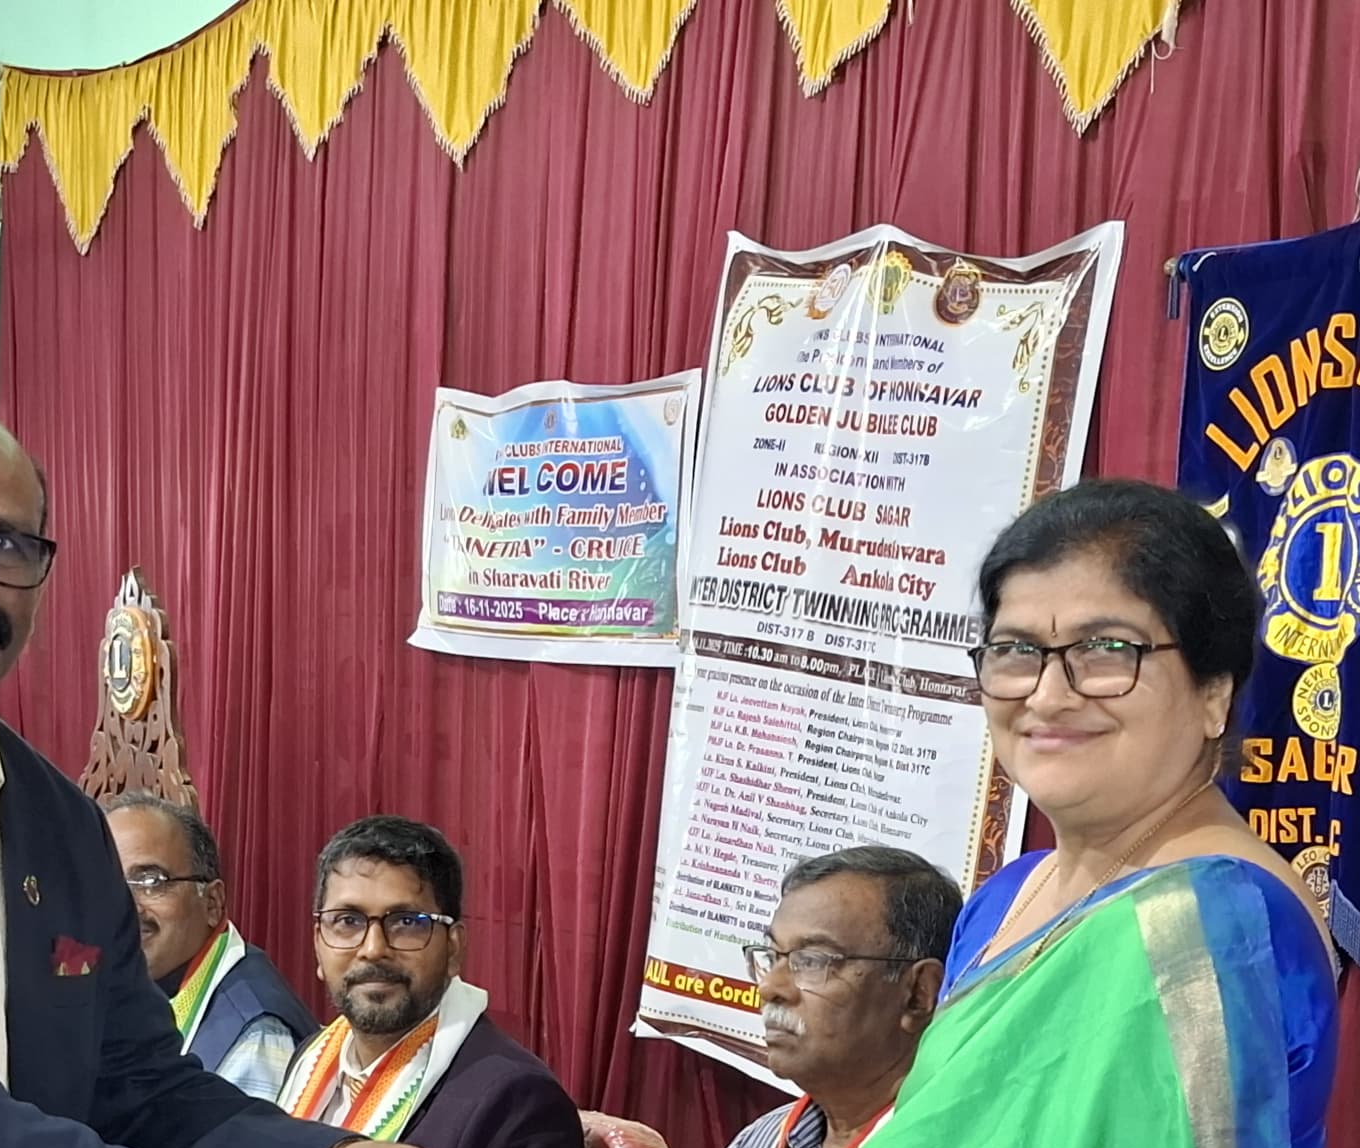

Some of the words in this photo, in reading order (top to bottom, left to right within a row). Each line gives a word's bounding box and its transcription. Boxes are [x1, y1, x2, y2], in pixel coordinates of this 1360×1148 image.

[927, 362, 944, 374] of
[753, 373, 796, 393] LIONS
[800, 373, 855, 397] CLUB
[890, 382, 983, 409] HONNAVAR
[1205, 313, 1356, 472] LIONS
[765, 403, 831, 426] GOLDEN
[837, 410, 898, 435] JUBILEE
[901, 414, 938, 437] CLUB
[775, 463, 788, 477] IN
[790, 464, 885, 491] ASSOCIATION
[557, 505, 610, 529] Family
[617, 505, 666, 524] Member
[757, 488, 805, 512] LIONS
[811, 494, 867, 521] CLUB
[875, 504, 911, 528] SAGAR
[719, 516, 759, 539] Lions
[763, 520, 812, 550] Club,
[483, 568, 561, 589] Sharavati
[568, 571, 611, 590] River
[717, 546, 757, 569] Lions
[761, 551, 806, 576] Club
[840, 564, 894, 592] Ankola
[898, 573, 936, 601] City
[464, 600, 523, 619] 16-11-2025
[539, 603, 577, 622] Place
[720, 578, 788, 611] DISTRICT
[792, 588, 879, 628] TWINNING
[880, 603, 980, 644] PROGRAMME
[757, 621, 804, 638] DIST-317
[807, 630, 815, 641] B
[1298, 668, 1323, 699] NEW
[758, 680, 768, 689] on
[770, 678, 782, 692] the
[820, 688, 831, 702] of
[832, 691, 846, 704] the
[907, 705, 953, 725] Programme
[807, 724, 835, 738] Region
[1298, 706, 1336, 736] SPONS
[805, 740, 833, 754] Region
[1240, 737, 1357, 795] SAGR
[809, 822, 832, 835] Lions
[910, 814, 928, 827] City
[1248, 807, 1324, 843] DIST.
[675, 974, 705, 994] are
[709, 977, 760, 1008] Cordi
